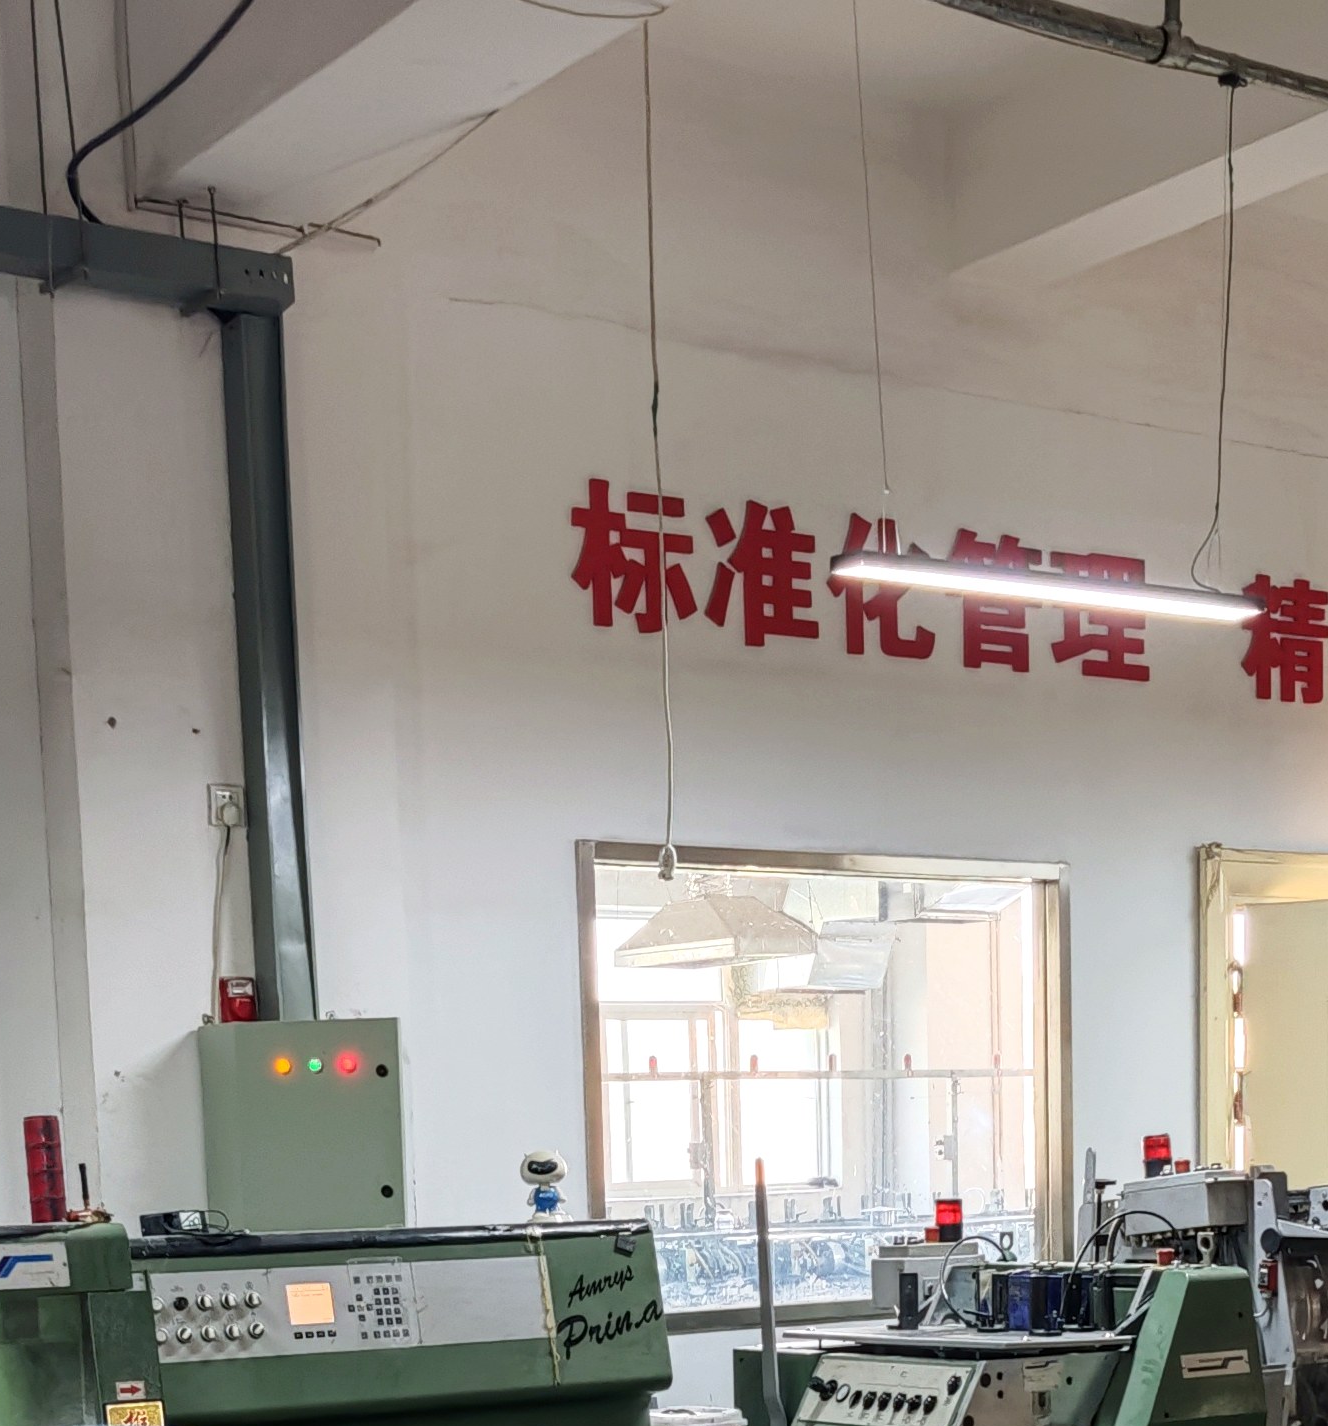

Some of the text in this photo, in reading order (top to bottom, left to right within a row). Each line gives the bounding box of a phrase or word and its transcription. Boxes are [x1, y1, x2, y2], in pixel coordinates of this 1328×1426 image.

[571, 477, 1151, 683] 标准化管理
